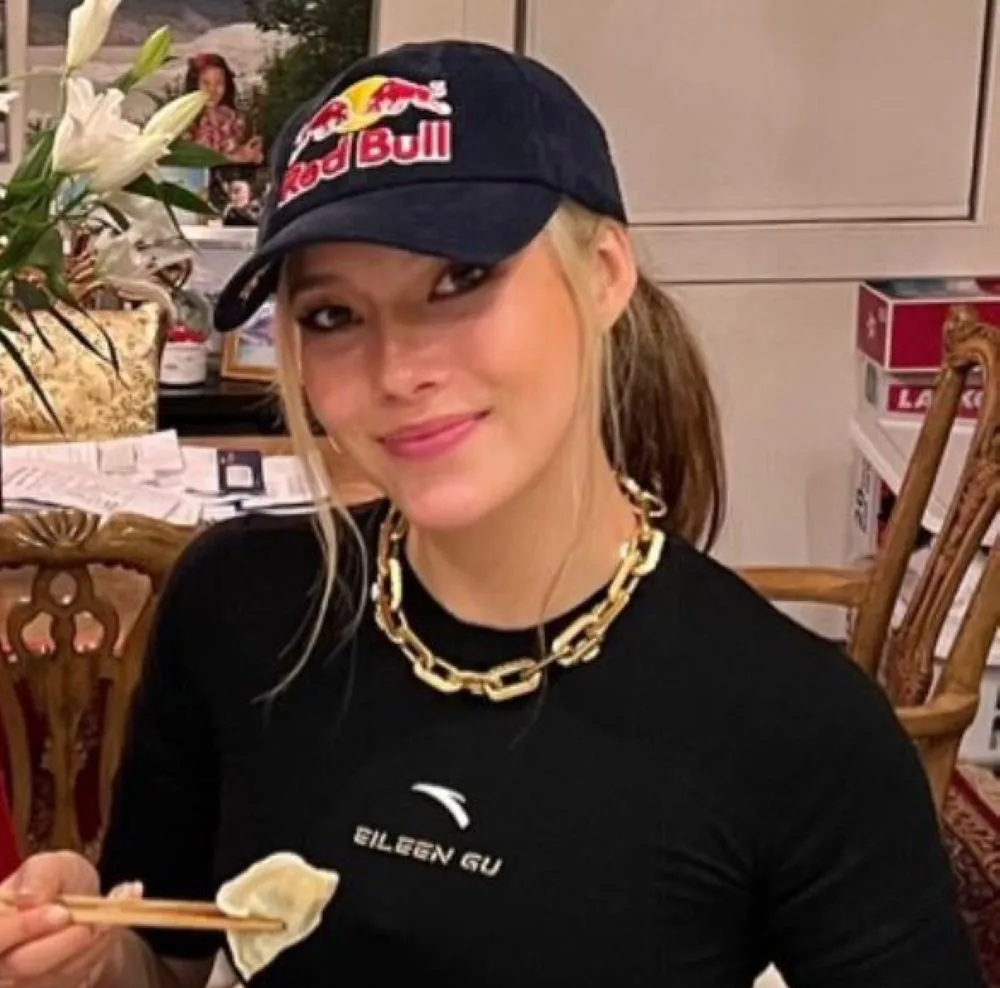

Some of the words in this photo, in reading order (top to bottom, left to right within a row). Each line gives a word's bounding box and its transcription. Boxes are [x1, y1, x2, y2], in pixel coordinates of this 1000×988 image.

[278, 132, 351, 207] Red
[357, 119, 451, 168] Bull
[353, 824, 455, 866] EILEEN
[460, 851, 503, 877] GU
